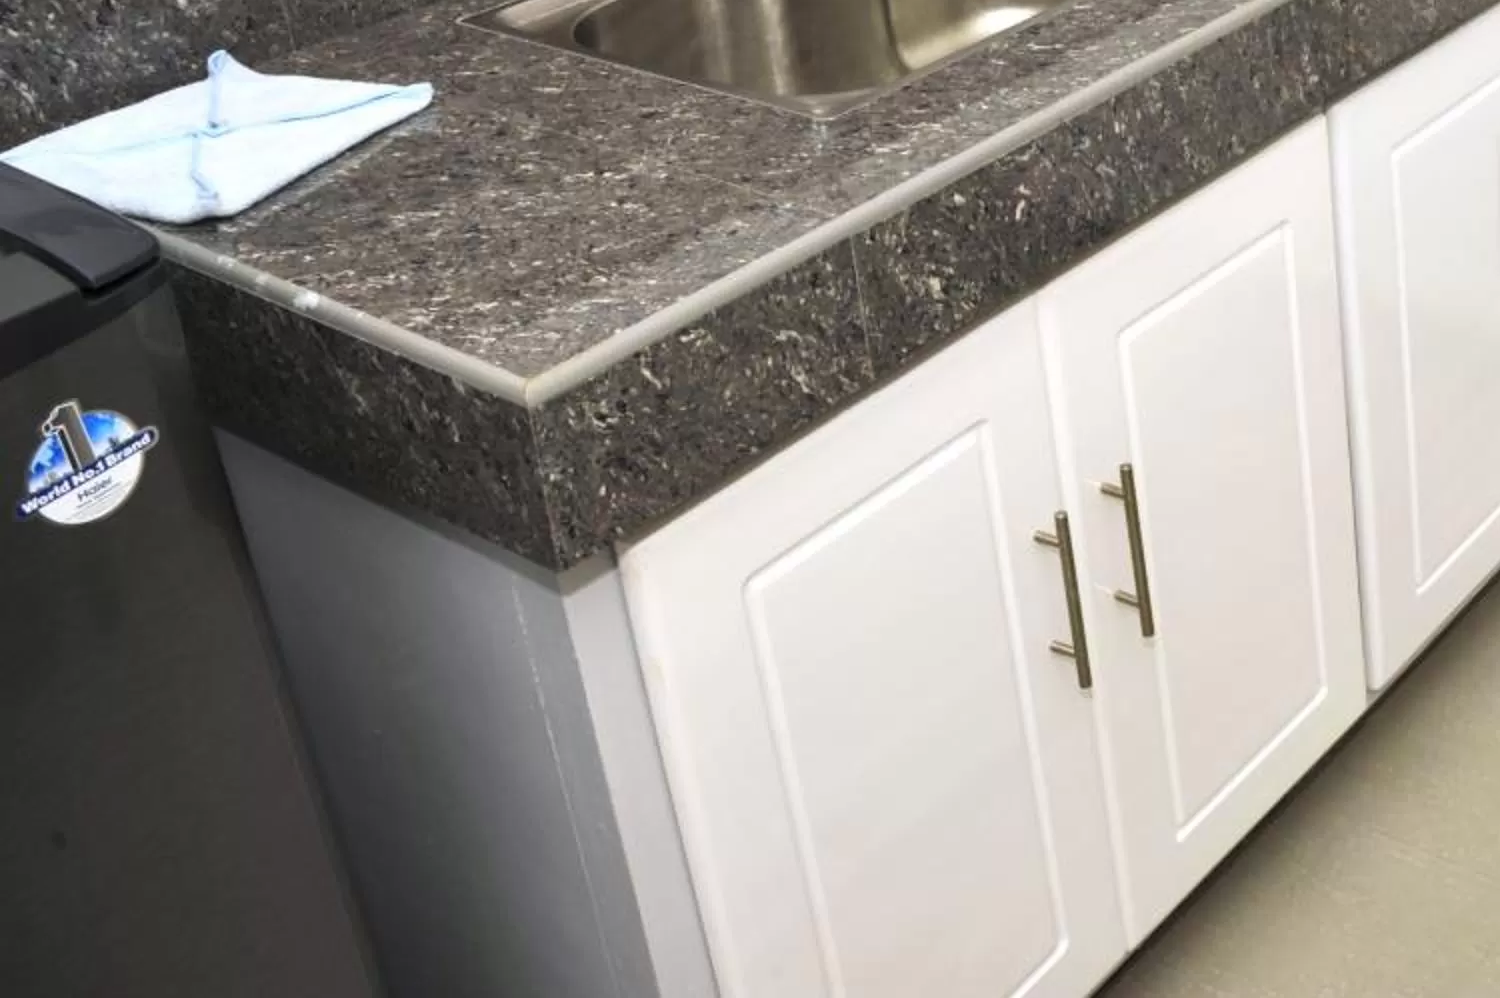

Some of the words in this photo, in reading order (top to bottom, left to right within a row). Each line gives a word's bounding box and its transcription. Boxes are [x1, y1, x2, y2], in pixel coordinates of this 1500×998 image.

[21, 481, 71, 514] World
[72, 460, 105, 486] No.1
[105, 433, 151, 466] Brand
